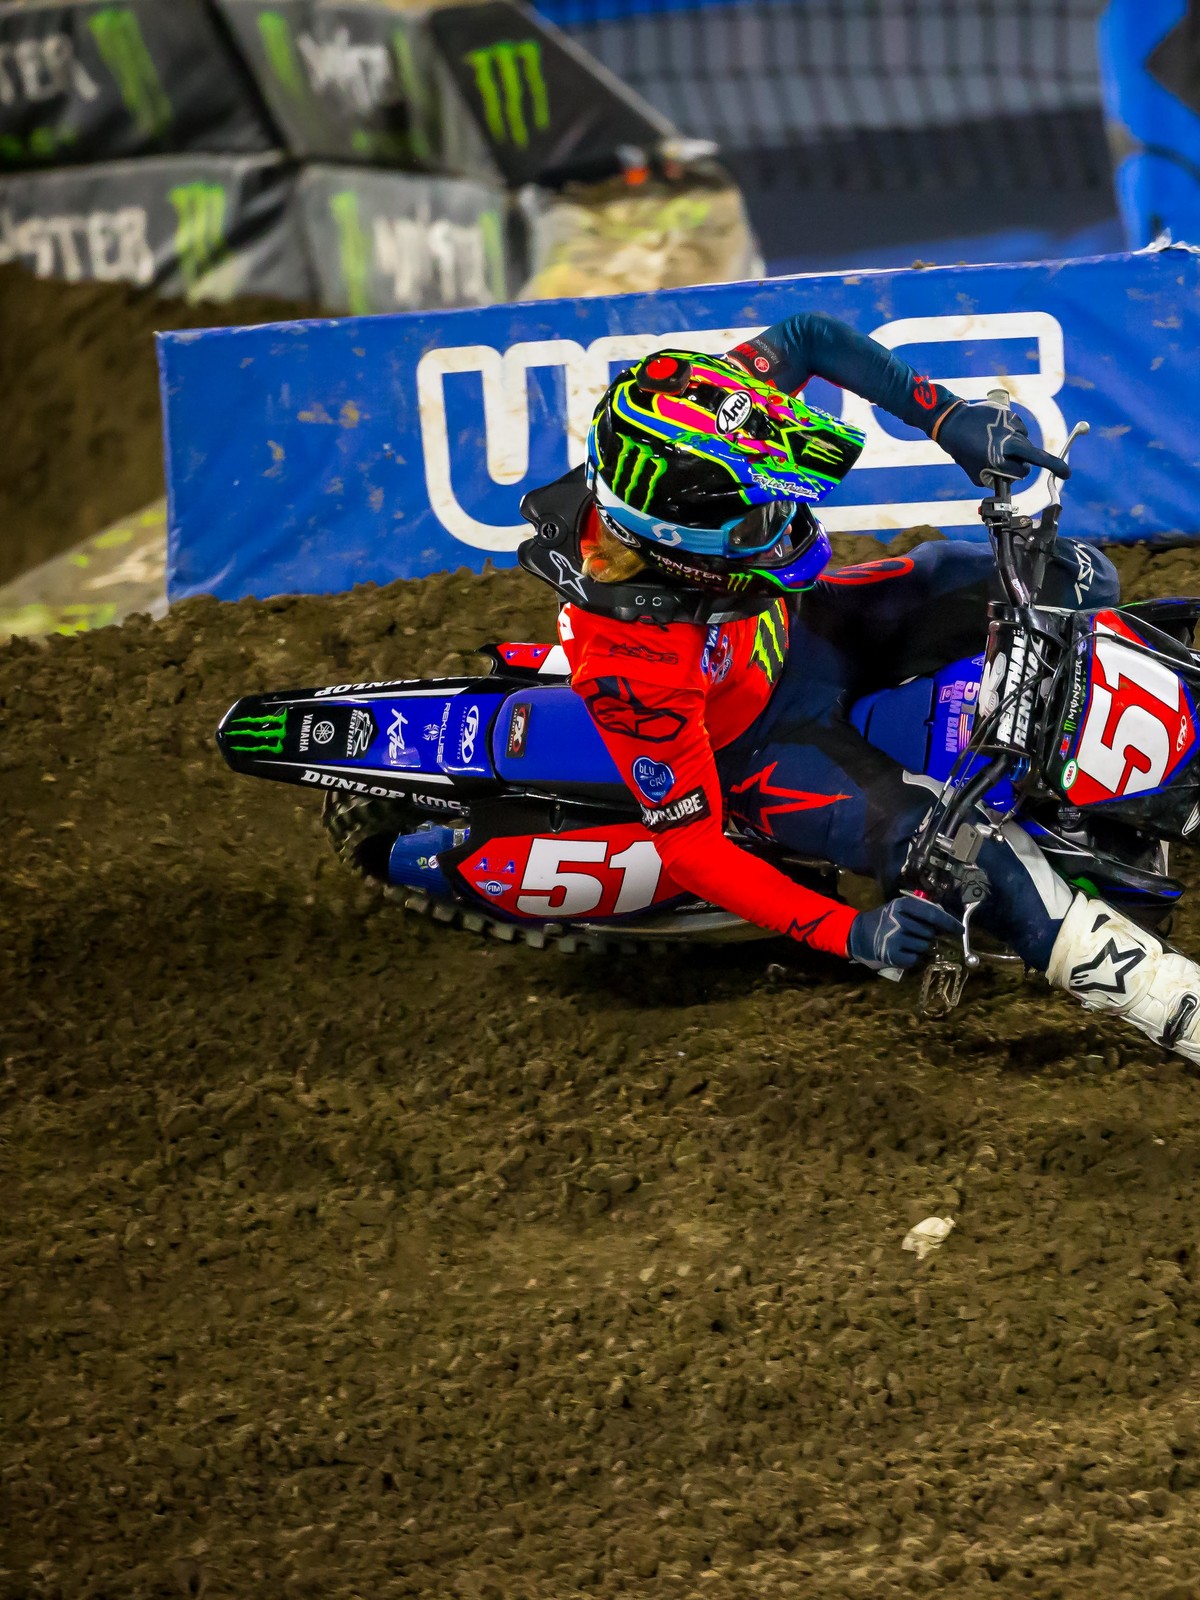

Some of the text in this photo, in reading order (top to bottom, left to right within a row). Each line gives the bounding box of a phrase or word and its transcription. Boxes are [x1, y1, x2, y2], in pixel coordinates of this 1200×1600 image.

[722, 392, 748, 432] Arai
[949, 680, 966, 714] BAM
[1068, 660, 1083, 720] MONSTER
[1077, 620, 1180, 796] 51
[299, 714, 313, 752] YAMAHA
[346, 709, 358, 757] RENTHAL
[436, 703, 451, 763] REKLUSE
[945, 717, 959, 752] BAM
[301, 770, 406, 798] DUNLOP
[649, 771, 666, 787] CRU
[516, 838, 663, 918] 51
